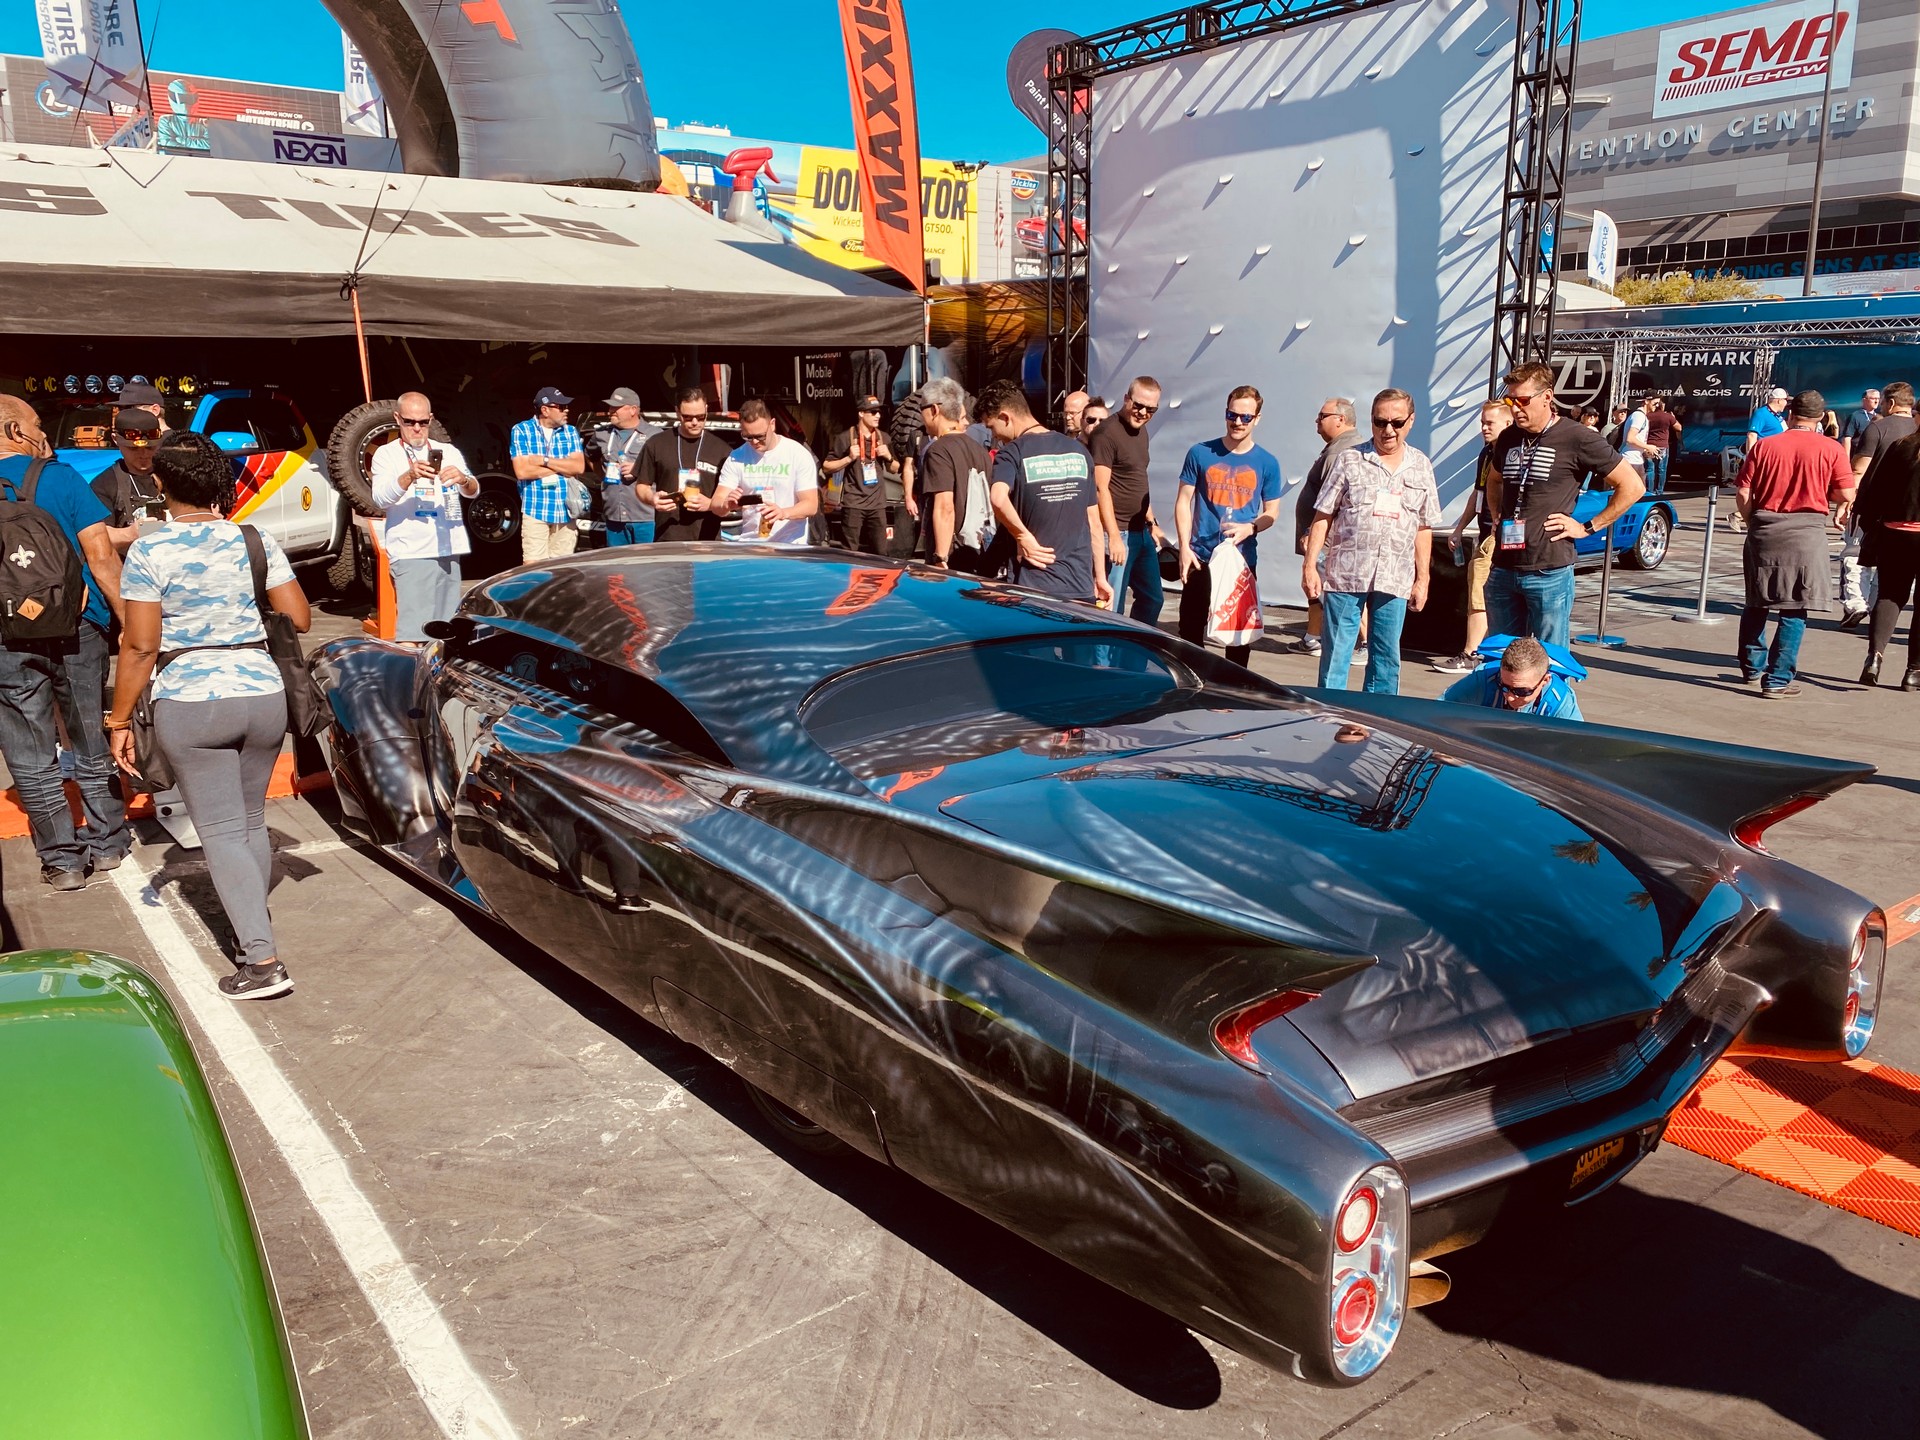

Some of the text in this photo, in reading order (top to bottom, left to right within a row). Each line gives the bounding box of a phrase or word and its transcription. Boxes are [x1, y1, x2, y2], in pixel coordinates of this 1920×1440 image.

[52, 2, 80, 56] TIRE
[103, 0, 125, 48] IRE
[1668, 11, 1850, 84] SEMA
[1745, 60, 1830, 85] SHOW
[1024, 79, 1047, 106] Paint
[1726, 96, 1876, 138] CENTER
[273, 138, 348, 166] NEXEN
[1011, 179, 1038, 190] Dickies
[184, 190, 640, 247] TIRES
[833, 215, 861, 228] Wicked
[1858, 254, 1889, 272] AT
[805, 363, 832, 379] Mobile
[1551, 355, 1596, 396] ZF
[806, 382, 844, 400] Operation
[1692, 388, 1732, 397] SACHS
[743, 463, 778, 474] Hurley
